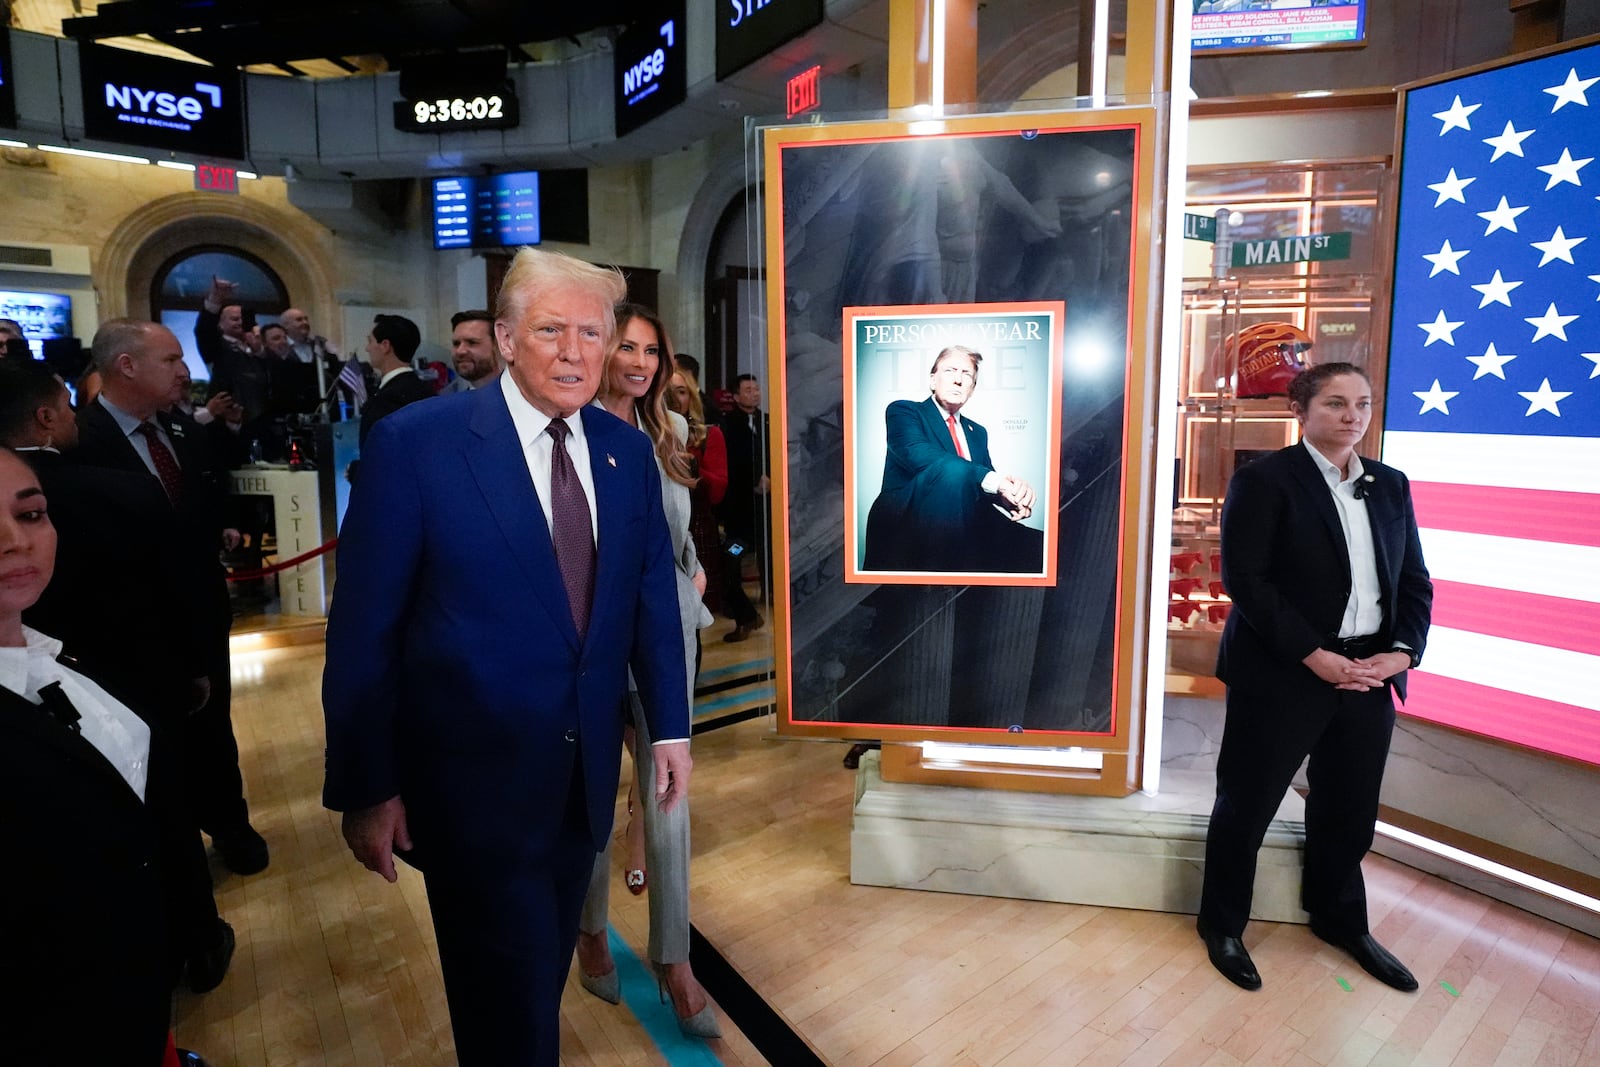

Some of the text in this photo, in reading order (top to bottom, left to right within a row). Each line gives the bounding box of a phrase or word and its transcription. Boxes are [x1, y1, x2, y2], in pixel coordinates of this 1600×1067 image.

[1303, 15, 1333, 23] ACKMAN
[790, 67, 820, 112] EXIT
[414, 95, 503, 124] 9:36:02
[199, 164, 236, 191] EXIT
[1199, 217, 1209, 229] ST
[1245, 236, 1330, 265] MAIN ST
[864, 324, 952, 344] PERSON
[977, 321, 1042, 341] YEAR
[875, 345, 1028, 393] TIE
